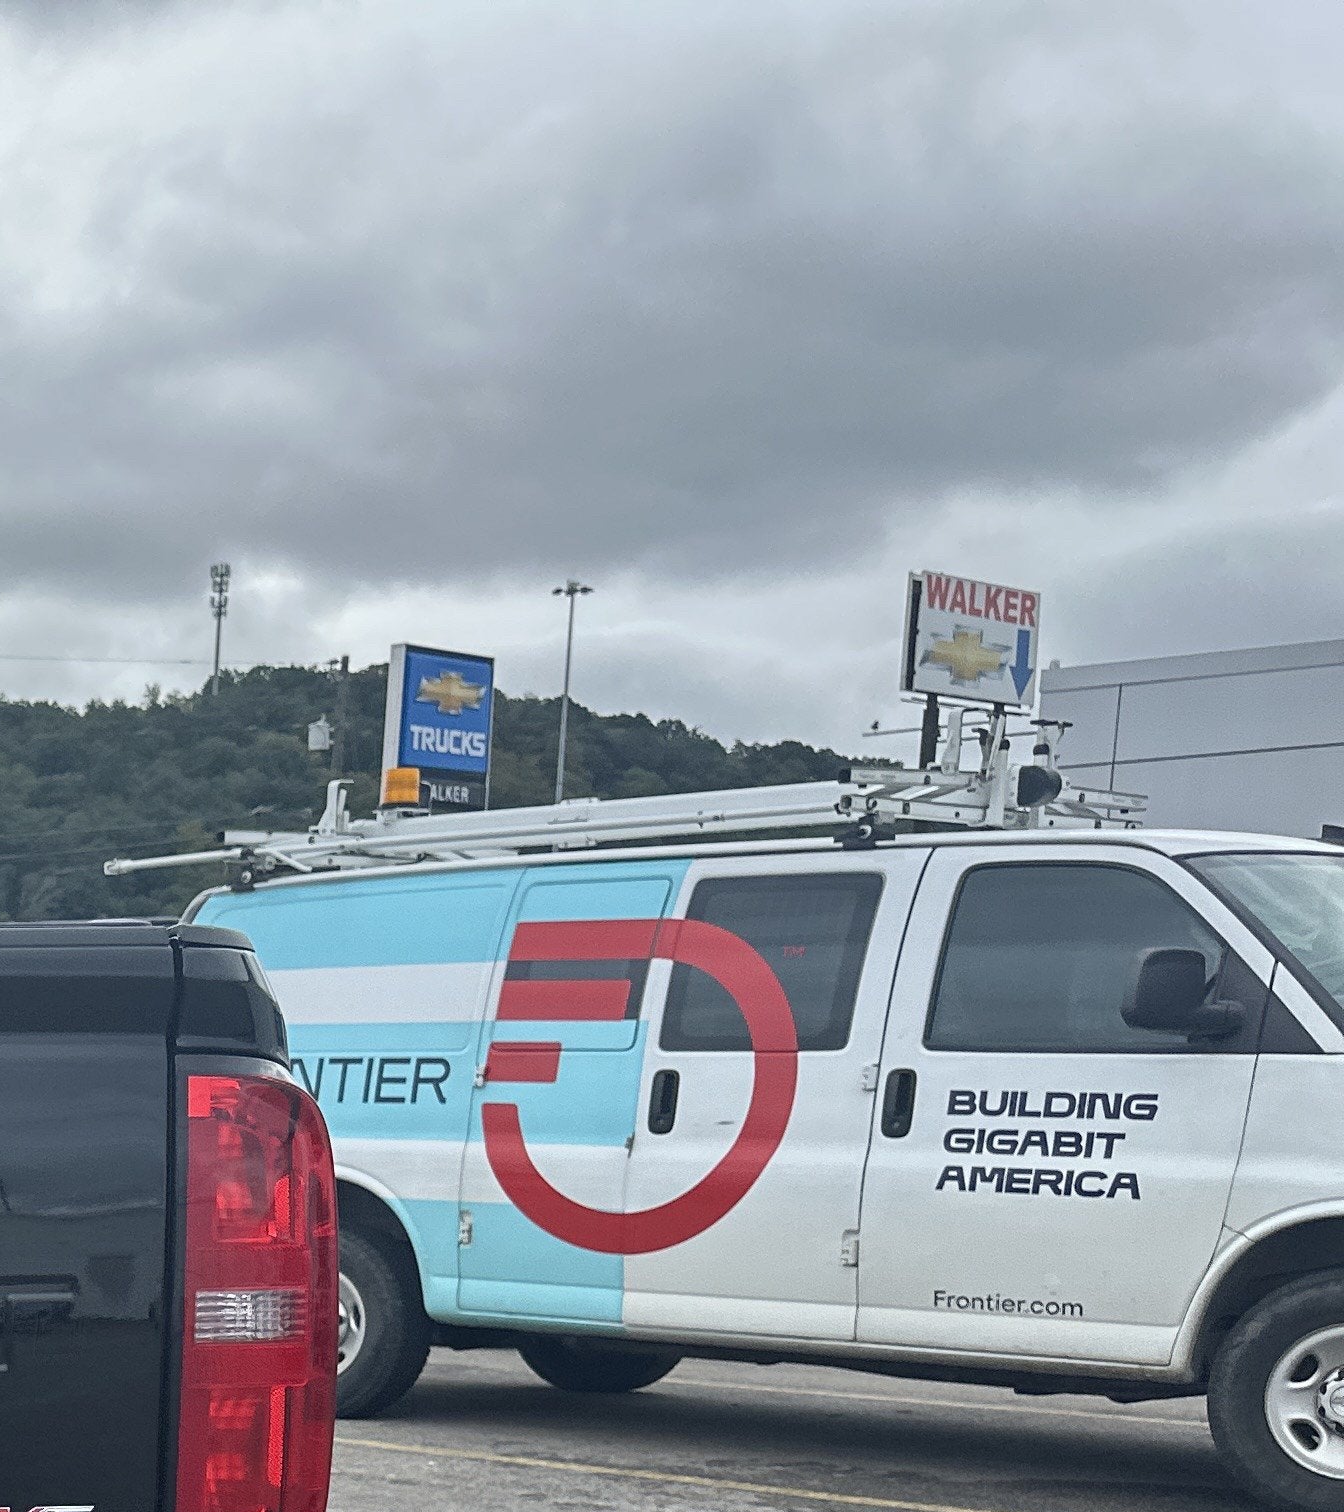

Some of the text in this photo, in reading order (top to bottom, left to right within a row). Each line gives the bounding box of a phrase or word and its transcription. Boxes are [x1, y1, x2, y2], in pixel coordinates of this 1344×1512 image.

[926, 574, 1037, 627] WALKER
[409, 724, 486, 757] TRUCKS
[430, 783, 469, 803] ALKER
[290, 1057, 451, 1104] NTIER
[946, 1090, 1159, 1121] BUILDING
[943, 1128, 1126, 1159] GIGABIT
[935, 1165, 1141, 1200] AMERICA
[933, 1290, 1083, 1317] Frontier.com
